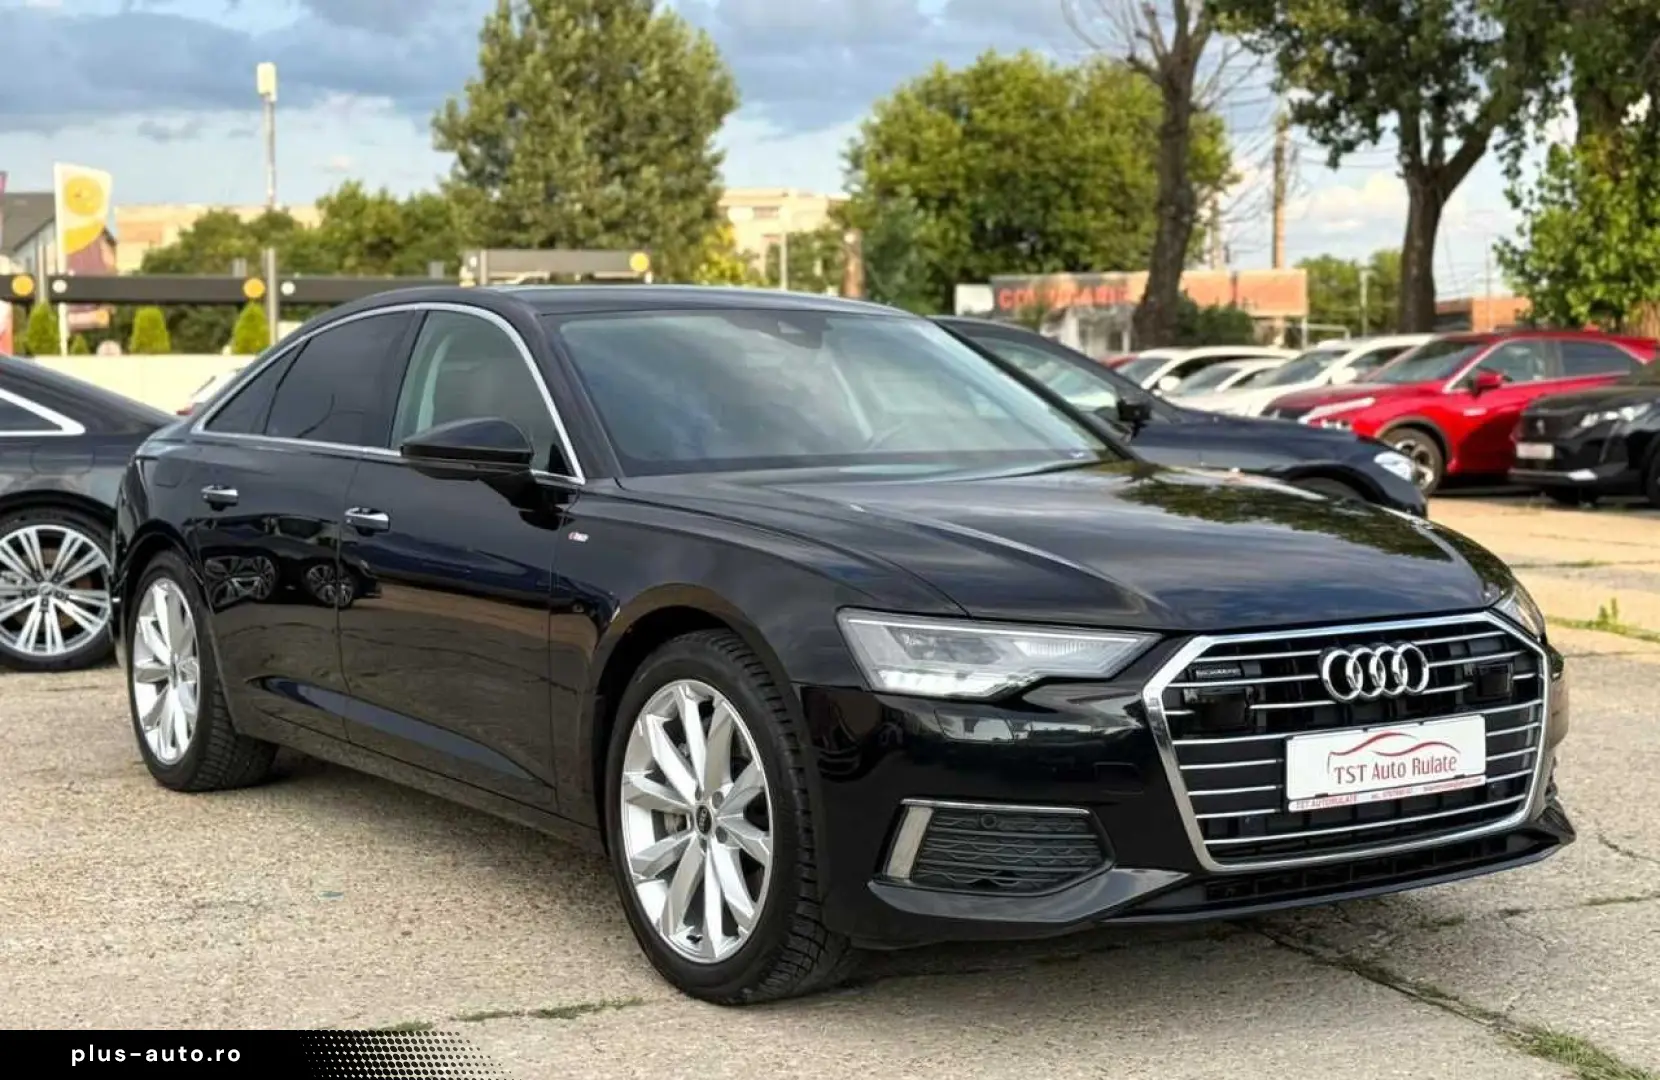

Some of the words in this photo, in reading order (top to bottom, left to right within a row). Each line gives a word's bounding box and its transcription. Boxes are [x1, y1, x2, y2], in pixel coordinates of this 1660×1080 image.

[1334, 764, 1367, 785] TST
[1371, 761, 1407, 781] Auto
[1412, 755, 1458, 777] Rulate
